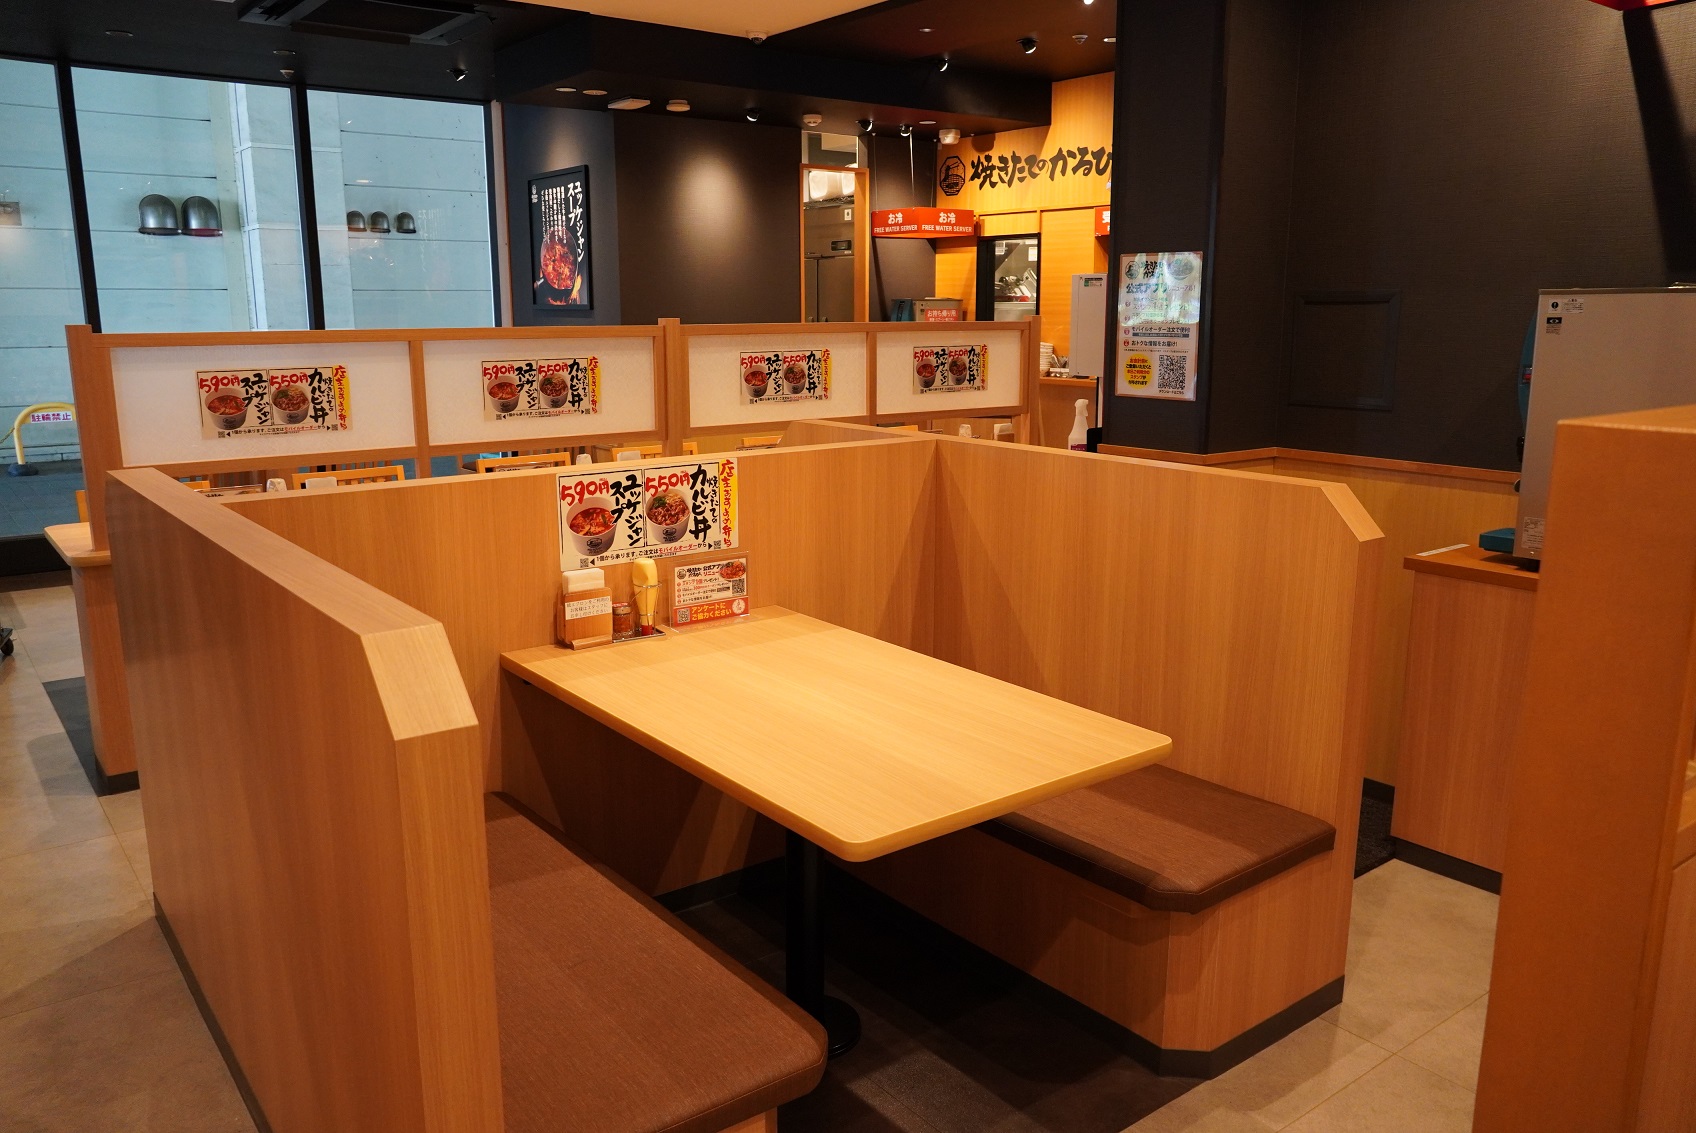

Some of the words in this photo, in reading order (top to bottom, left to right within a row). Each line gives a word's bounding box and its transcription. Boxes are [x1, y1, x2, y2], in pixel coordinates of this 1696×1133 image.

[567, 182, 576, 226] スープ
[574, 181, 584, 262] ユッケジャン
[888, 212, 903, 224] お冷
[938, 211, 956, 224] お冷
[741, 355, 766, 369] 590円
[783, 354, 807, 367] 550円
[913, 349, 935, 362] 590円
[948, 349, 968, 360] 550円
[483, 364, 515, 380] 590円
[515, 366, 525, 394] スープ
[538, 363, 568, 378] 550円
[765, 357, 774, 380] スープ
[199, 375, 241, 393] 590円
[239, 377, 254, 408] スープ
[270, 373, 309, 390] 550円
[523, 362, 538, 409] ユッケジャン
[568, 358, 583, 409] カルビ丼
[250, 372, 270, 425] ユッケジャン
[308, 368, 329, 426] カルビ丼
[31, 412, 72, 422] 駐輪禁止
[561, 480, 610, 506] 590円
[645, 473, 690, 497] 550円
[610, 481, 627, 524] スープ
[622, 474, 643, 546] ユッケジャン
[689, 463, 711, 542] カルビ丼
[706, 475, 720, 523] 焼きたての
[570, 602, 608, 613] お客様はスタッフに
[691, 602, 726, 613] アンケートに
[691, 608, 732, 621] ご協力ください
